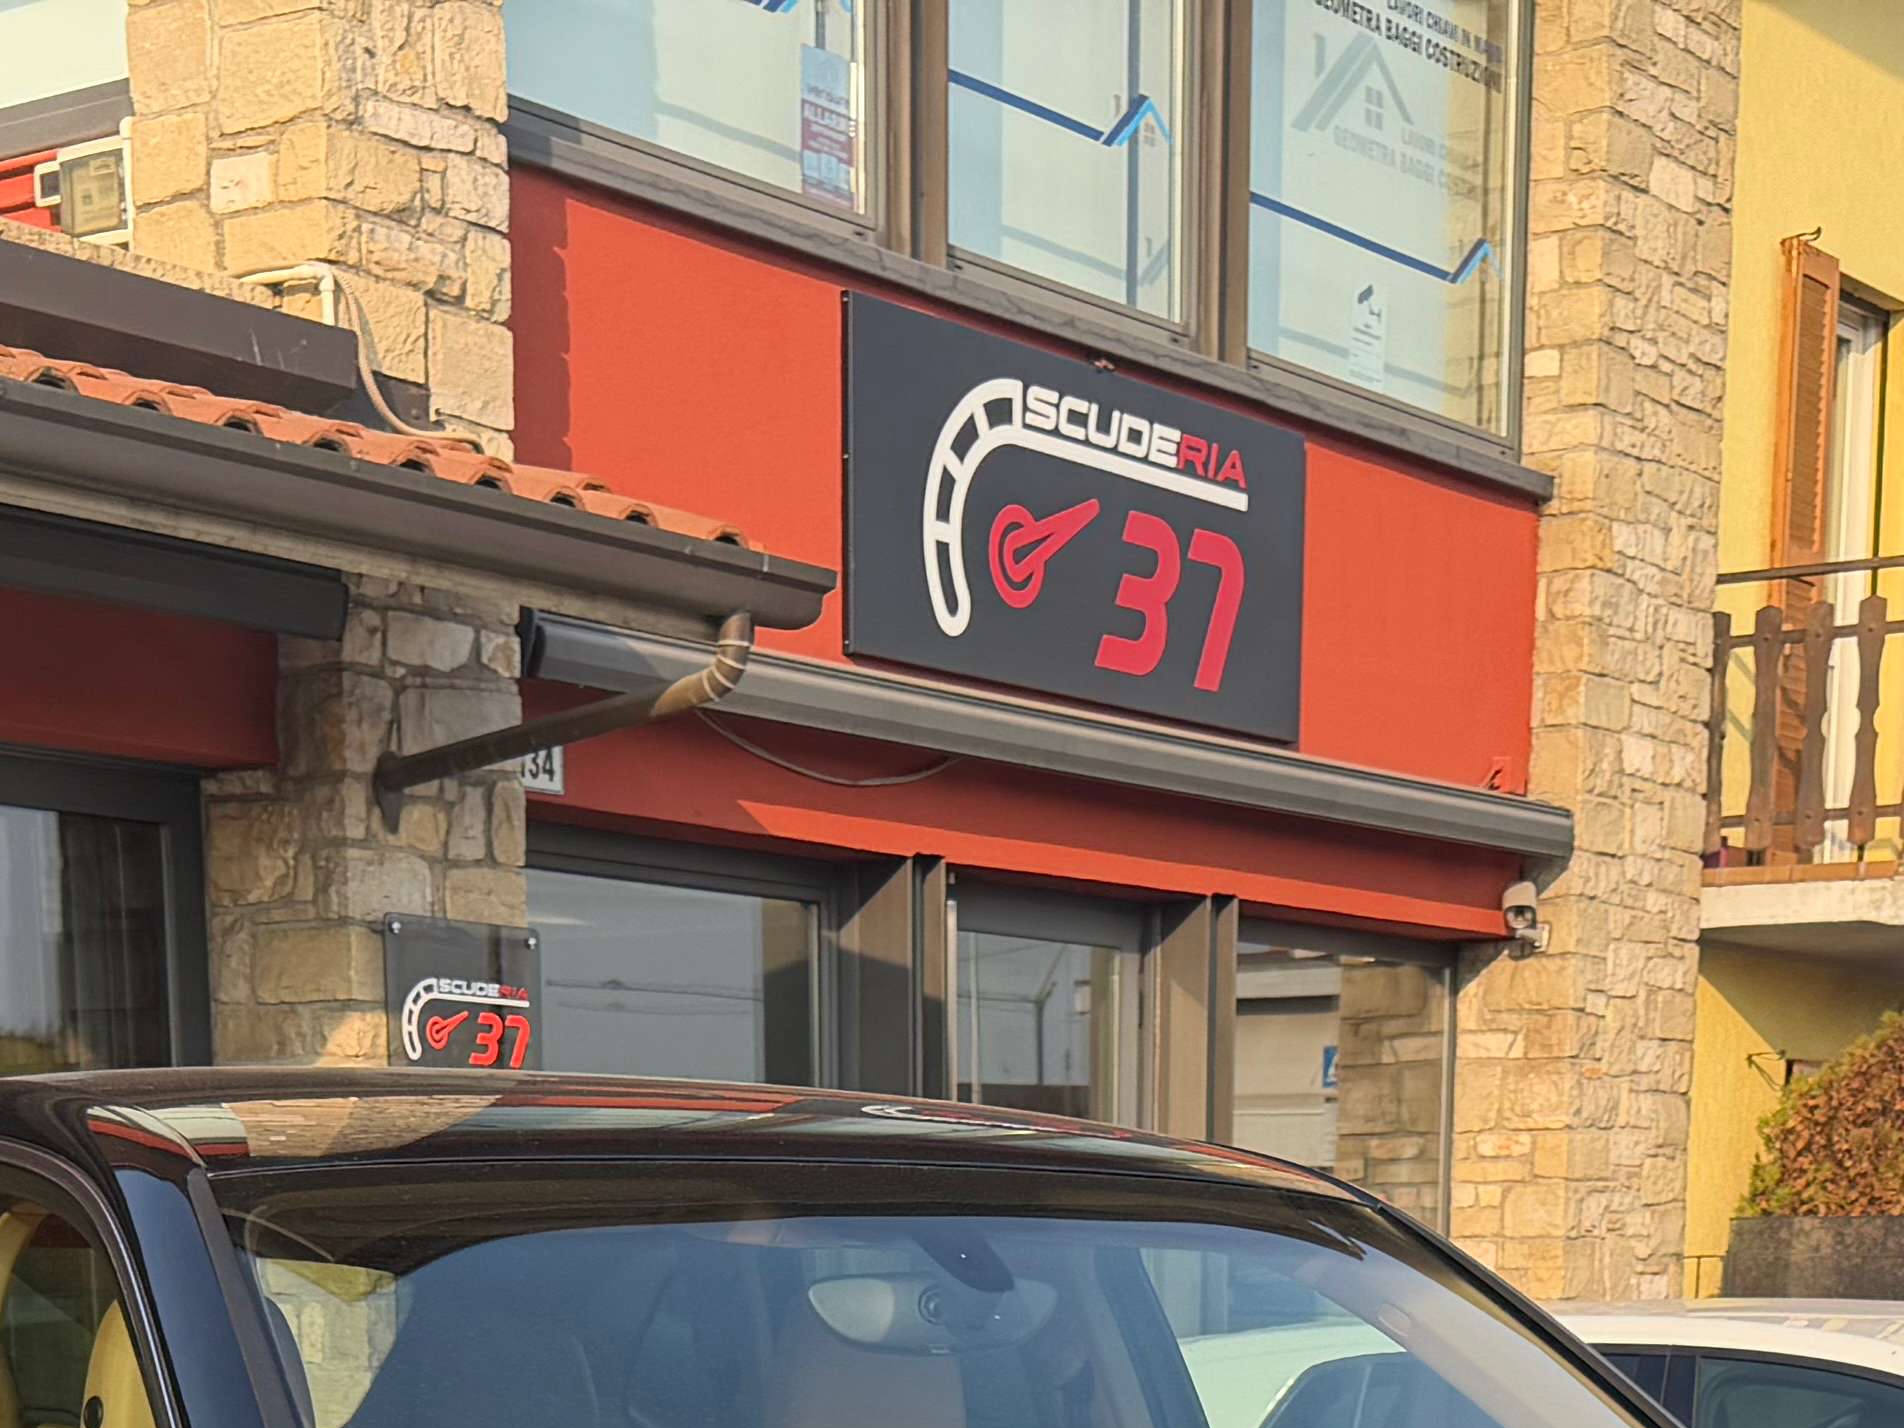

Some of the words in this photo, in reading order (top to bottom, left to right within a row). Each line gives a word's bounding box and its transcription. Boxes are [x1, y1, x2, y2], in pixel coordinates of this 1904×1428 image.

[1024, 384, 1247, 489] SCUDERIA
[1094, 509, 1245, 693] 37
[438, 977, 529, 1001] SCUDERIA
[469, 1010, 531, 1070] 37
